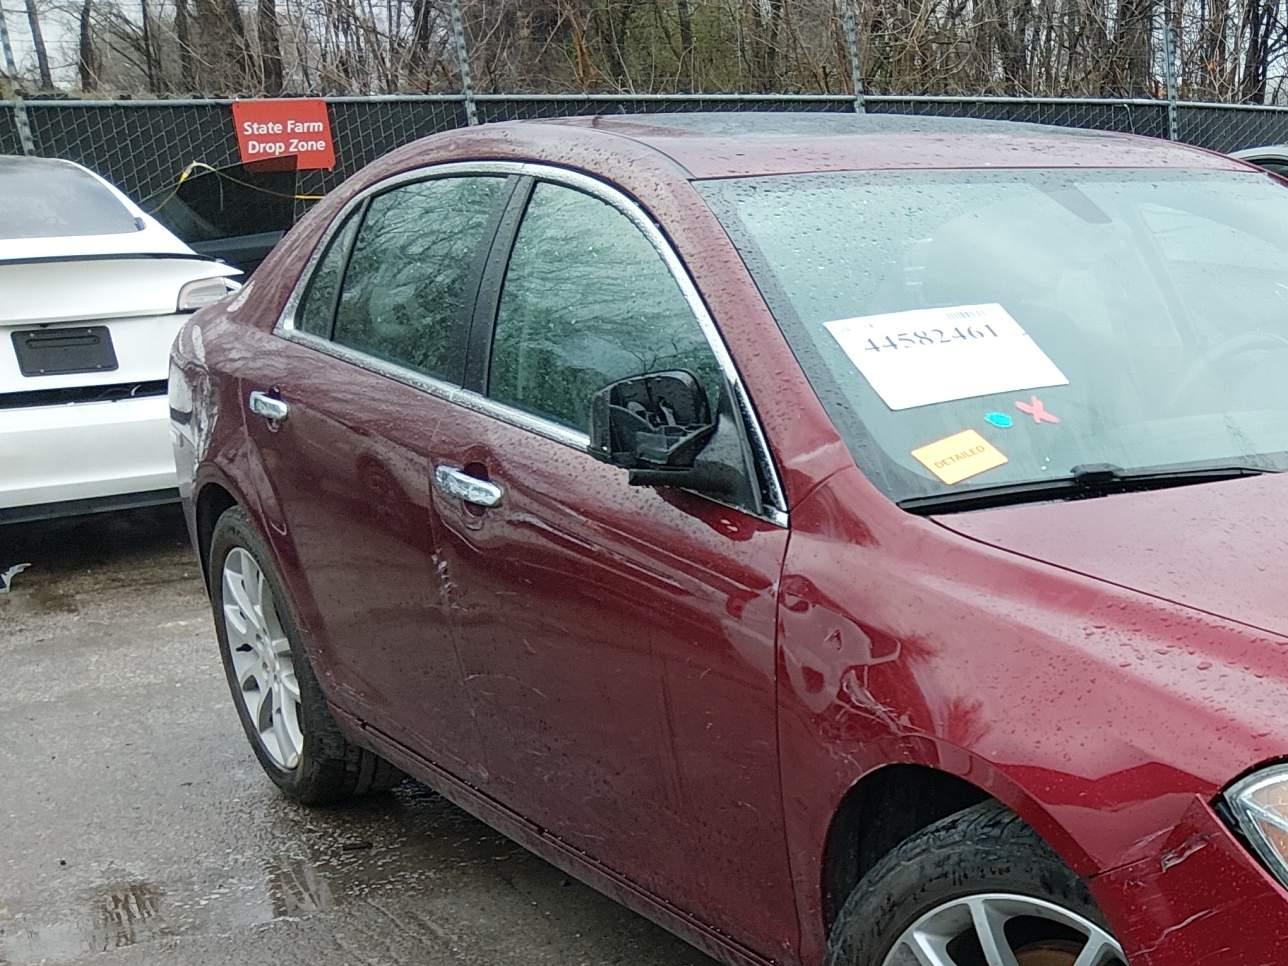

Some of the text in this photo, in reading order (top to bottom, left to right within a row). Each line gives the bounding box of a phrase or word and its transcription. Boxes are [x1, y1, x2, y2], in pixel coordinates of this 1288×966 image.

[243, 120, 323, 135] State Farm
[248, 138, 326, 156] Drop Zone
[864, 323, 999, 352] 44582461
[933, 444, 986, 469] DETAILED
